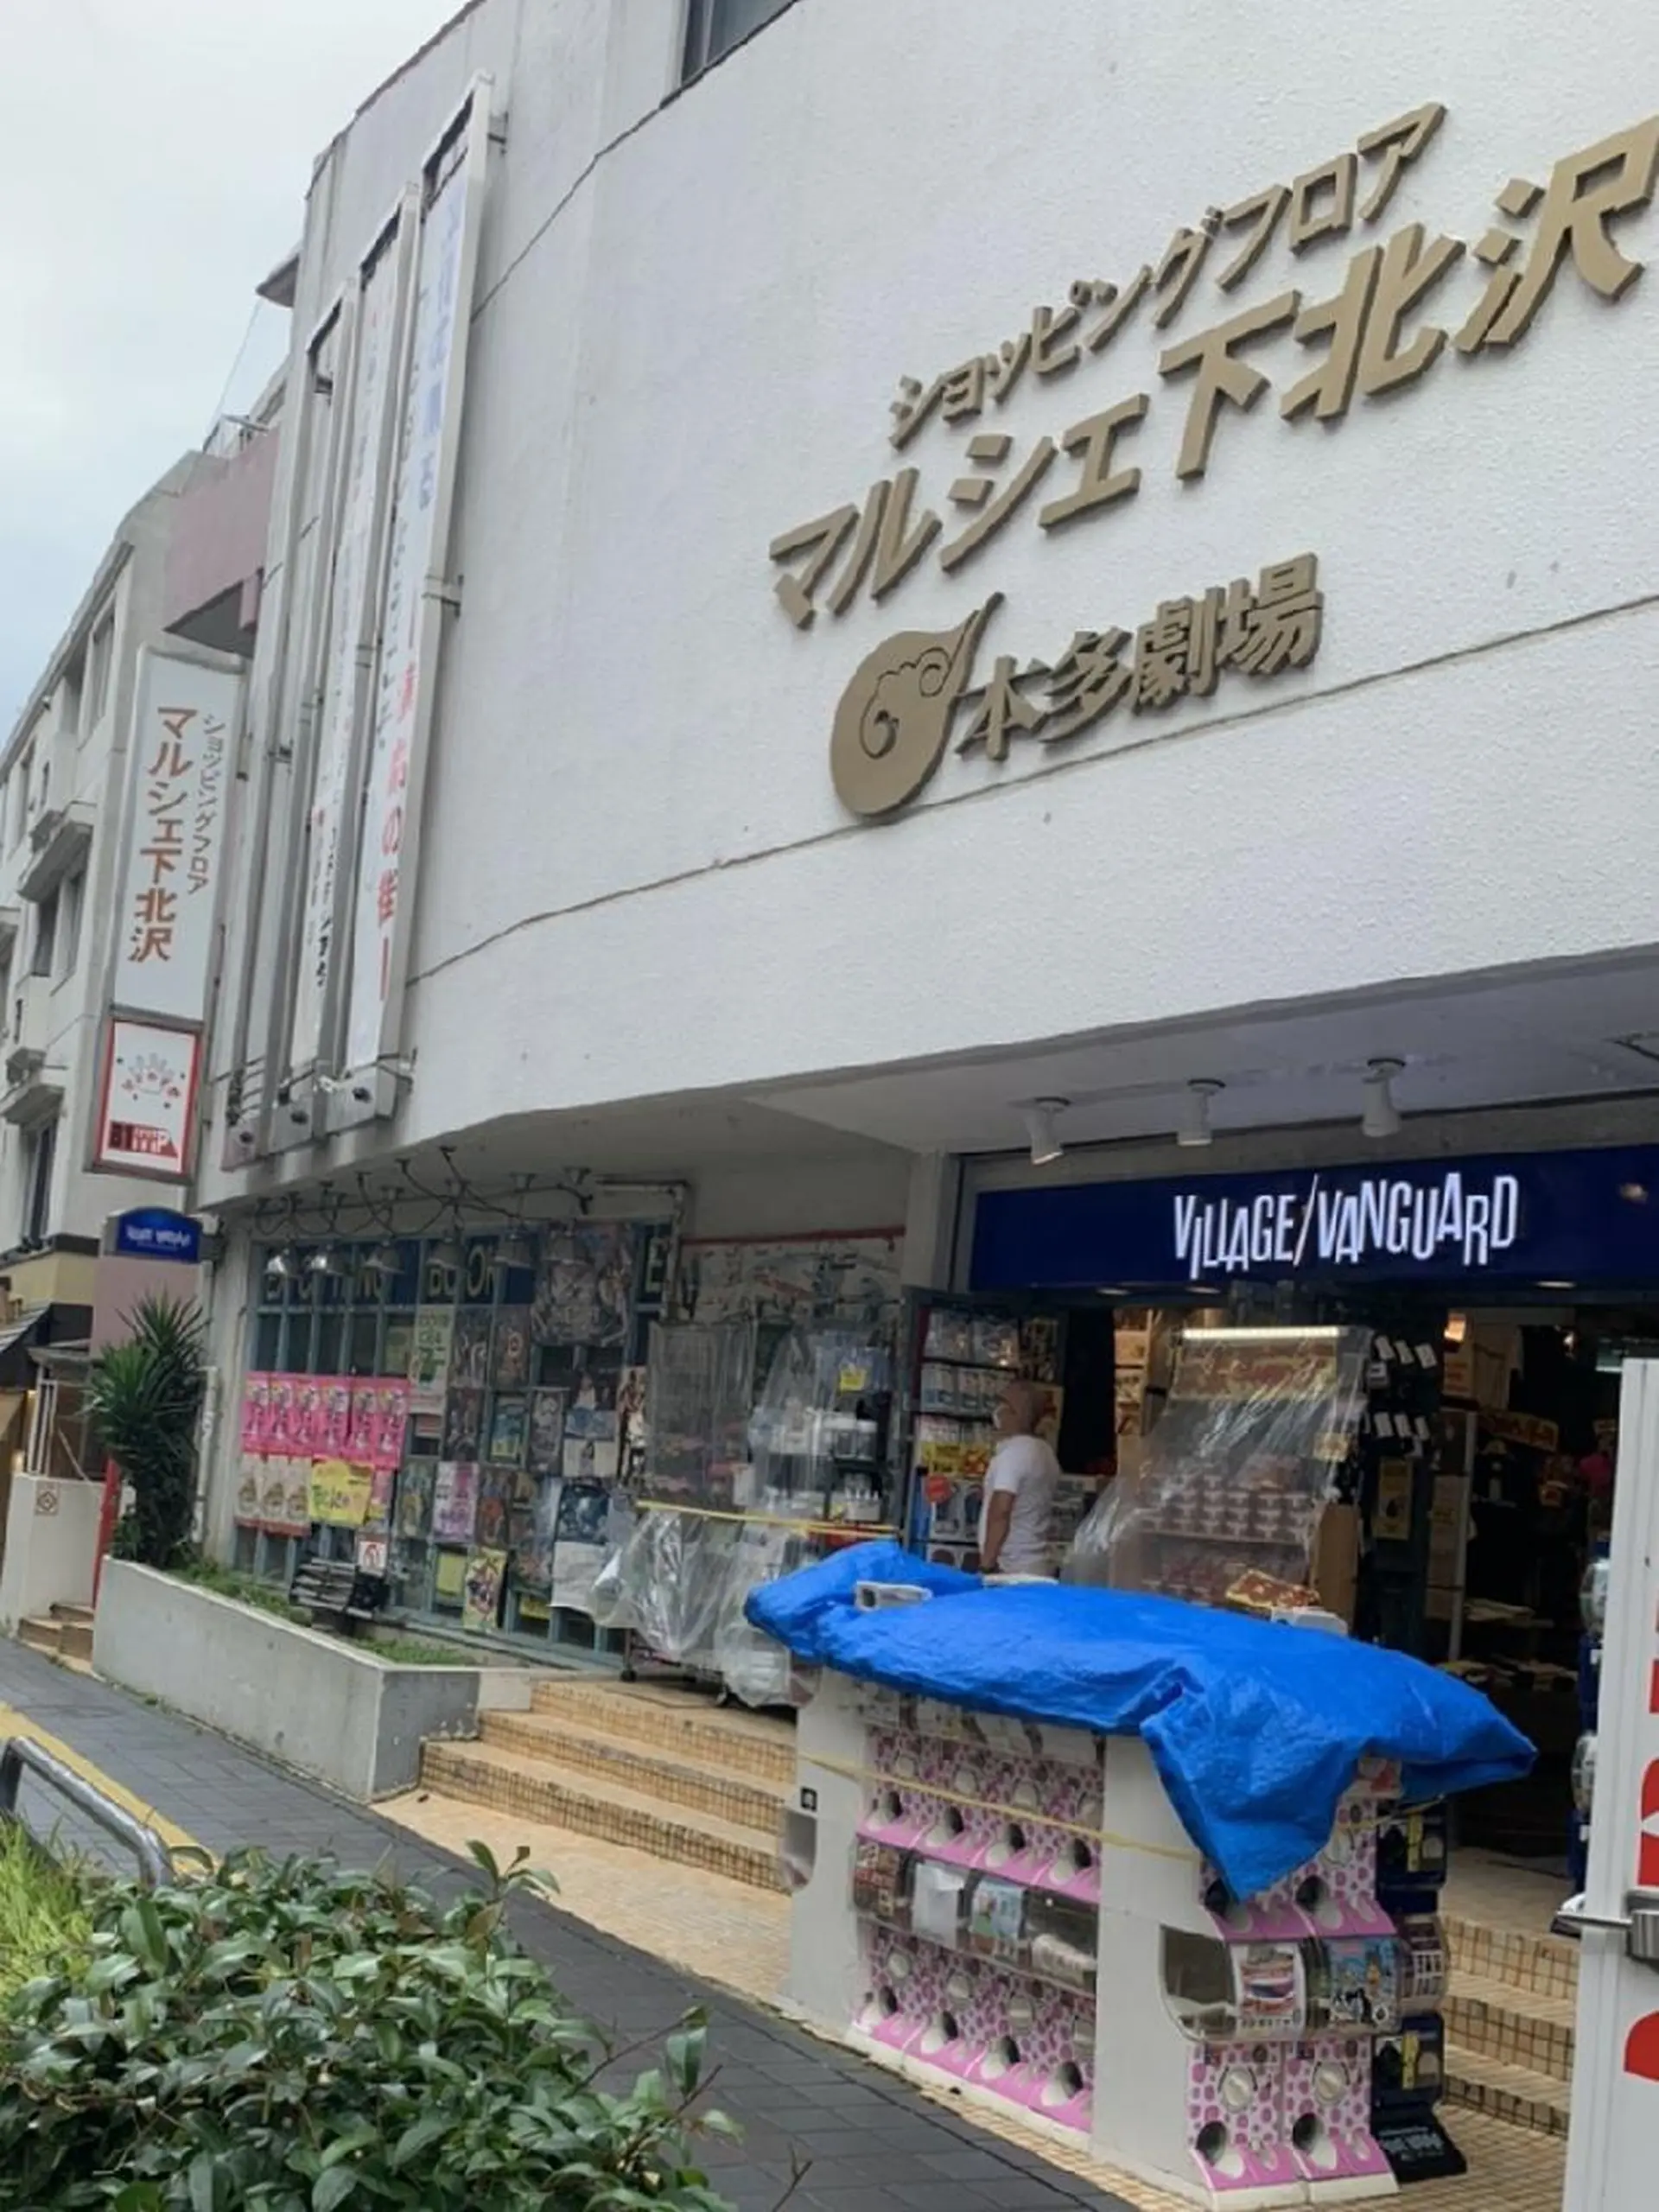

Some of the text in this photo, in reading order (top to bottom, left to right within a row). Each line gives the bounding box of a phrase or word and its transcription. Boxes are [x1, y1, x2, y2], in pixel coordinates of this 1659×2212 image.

[889, 100, 1449, 448] ショッピングフロア
[955, 551, 1325, 762] 本多劇場
